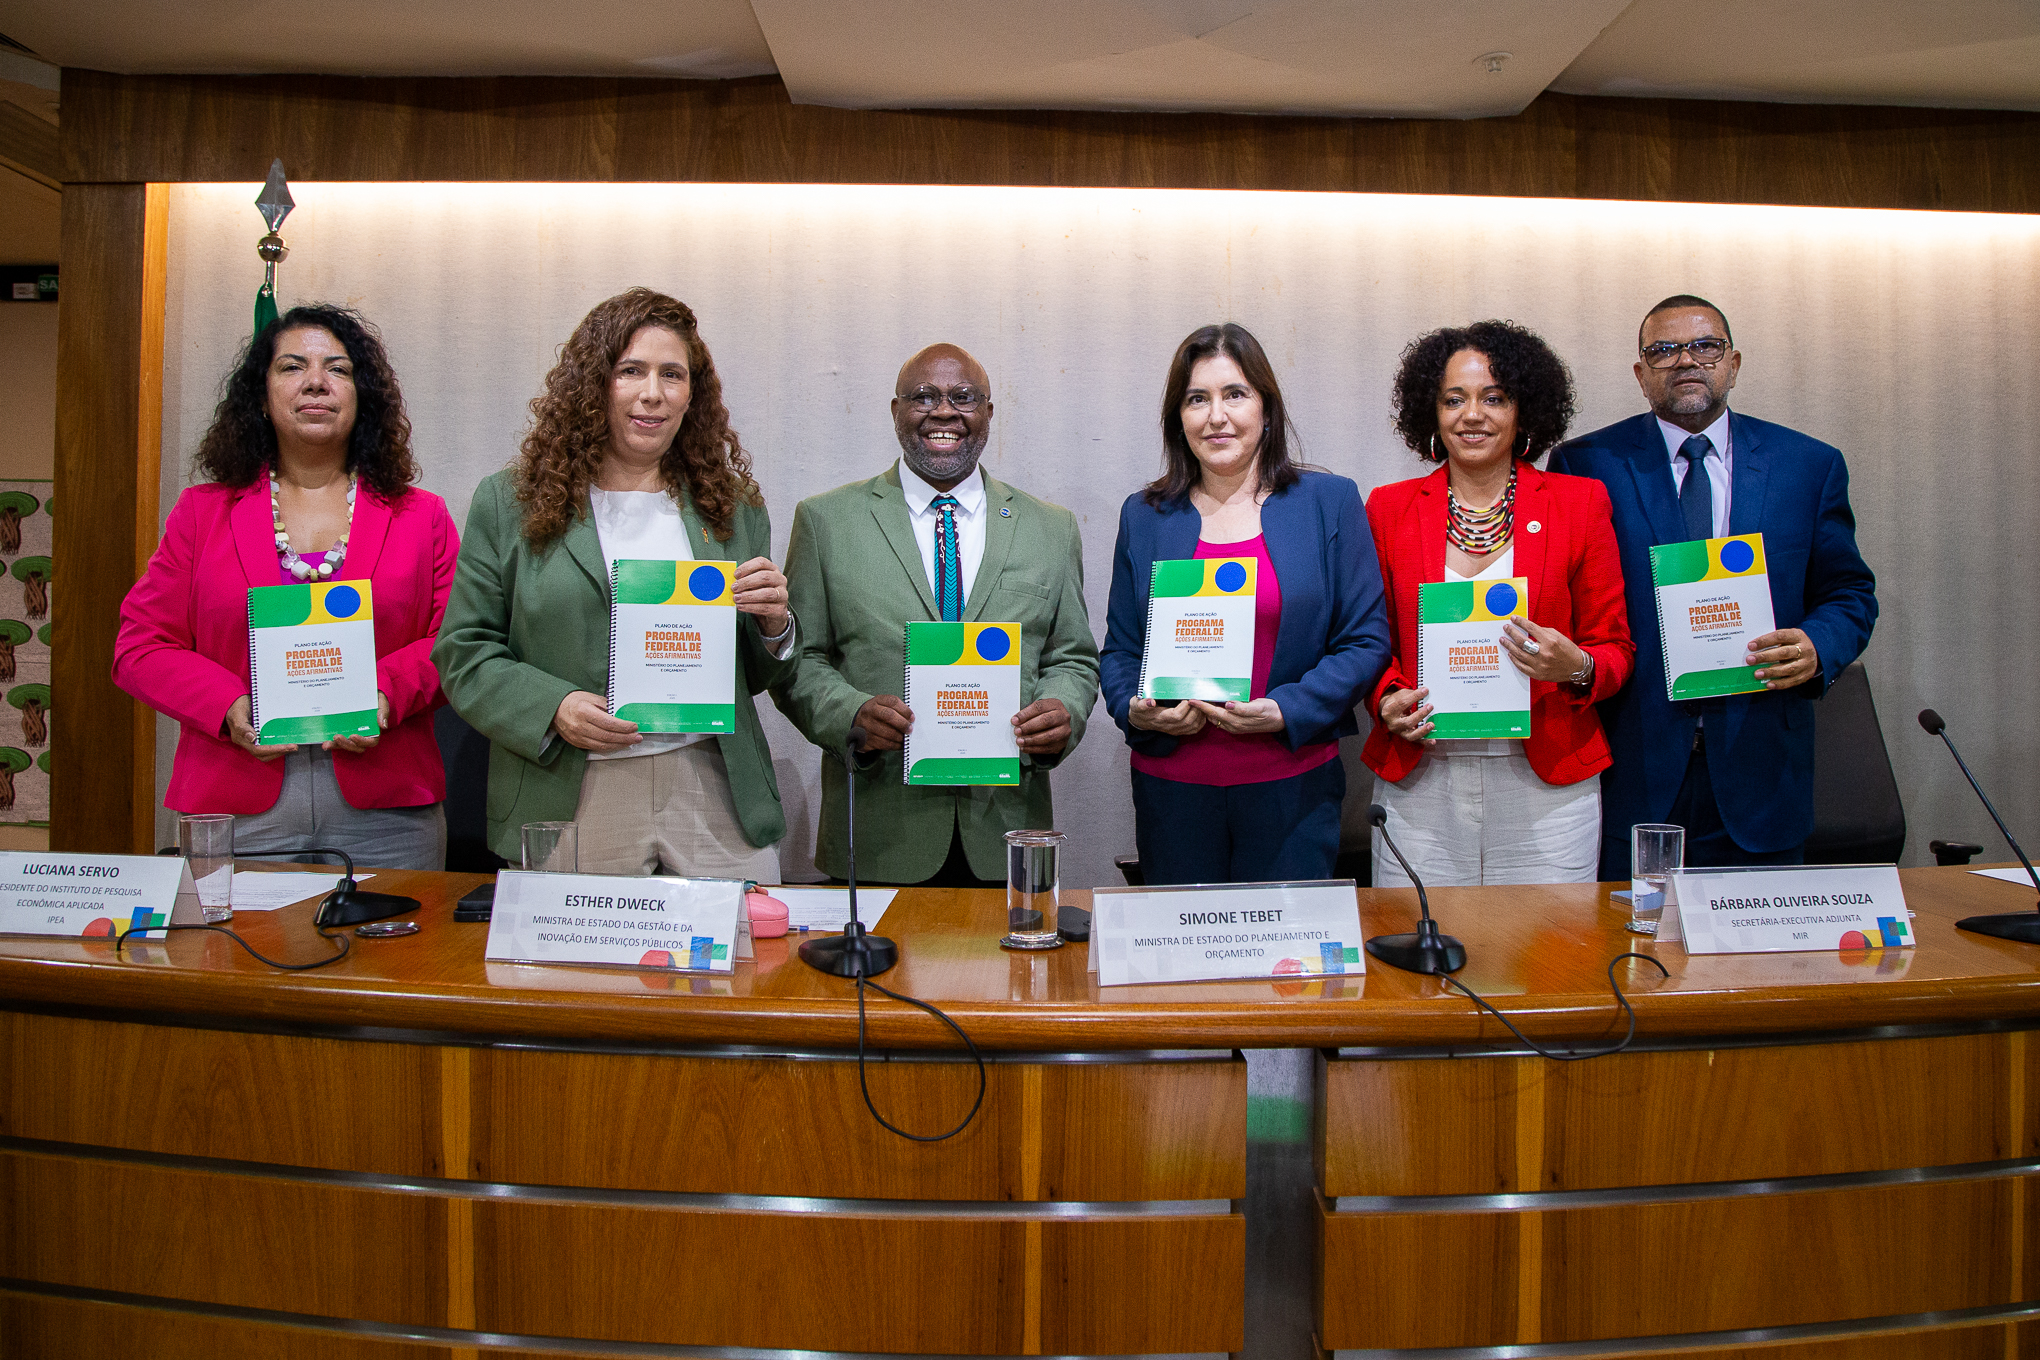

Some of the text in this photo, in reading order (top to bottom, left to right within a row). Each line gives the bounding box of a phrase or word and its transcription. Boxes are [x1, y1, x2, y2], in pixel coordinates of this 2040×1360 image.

[1688, 602, 1740, 616] PROGRAMA
[1176, 619, 1224, 627] PROGRAMA
[1689, 611, 1742, 625] FEDERAL DE
[1175, 628, 1224, 636] FEDERAL DE
[1691, 620, 1742, 633] AÇÕES AFIRMATIVAS
[645, 631, 702, 642] PROGRAMA
[645, 641, 702, 652] FEDERAL DE
[1449, 645, 1499, 656] PROGRAMA
[286, 647, 342, 660] PROGRAMA
[645, 651, 664, 660] AÇÕES
[286, 657, 343, 670] FEDERAL DE
[1449, 655, 1500, 666] FEDERAL DE
[287, 666, 343, 677] AÇÕES AFIRMATIVAS
[1449, 665, 1466, 673] AÇÕES
[937, 690, 988, 700] PROGRAMA
[937, 701, 989, 710] FEDERAL DE
[937, 709, 954, 718] AÇÕES
[23, 864, 120, 878] LUCIANA SERVO
[50, 885, 90, 894] INSTITUTO
[92, 887, 103, 895] DE
[104, 888, 142, 897] PESQUISA
[17, 898, 104, 910] ECONÔMICA APLICADA
[565, 894, 666, 912] ESTHER DWECK
[1710, 893, 1873, 911] BÁRBARA OLIVEIRA SOUZA
[533, 915, 693, 933] MINISTRA DE ESTADO DA GESTÃO E DA
[1179, 910, 1282, 926] SIMONE TEBET
[1731, 914, 1862, 928] SECRETÁRIA-EXECUTIVA ADJUNTA
[537, 932, 684, 949] INOVAÇÃO EM SERVIÇOS PÚBLICOS
[1134, 931, 1329, 947] MINISTRA DE ESTADO DO PLANEJAMENTO E
[1792, 932, 1809, 940] MIR
[1205, 948, 1265, 960] ORÇAMENTO
